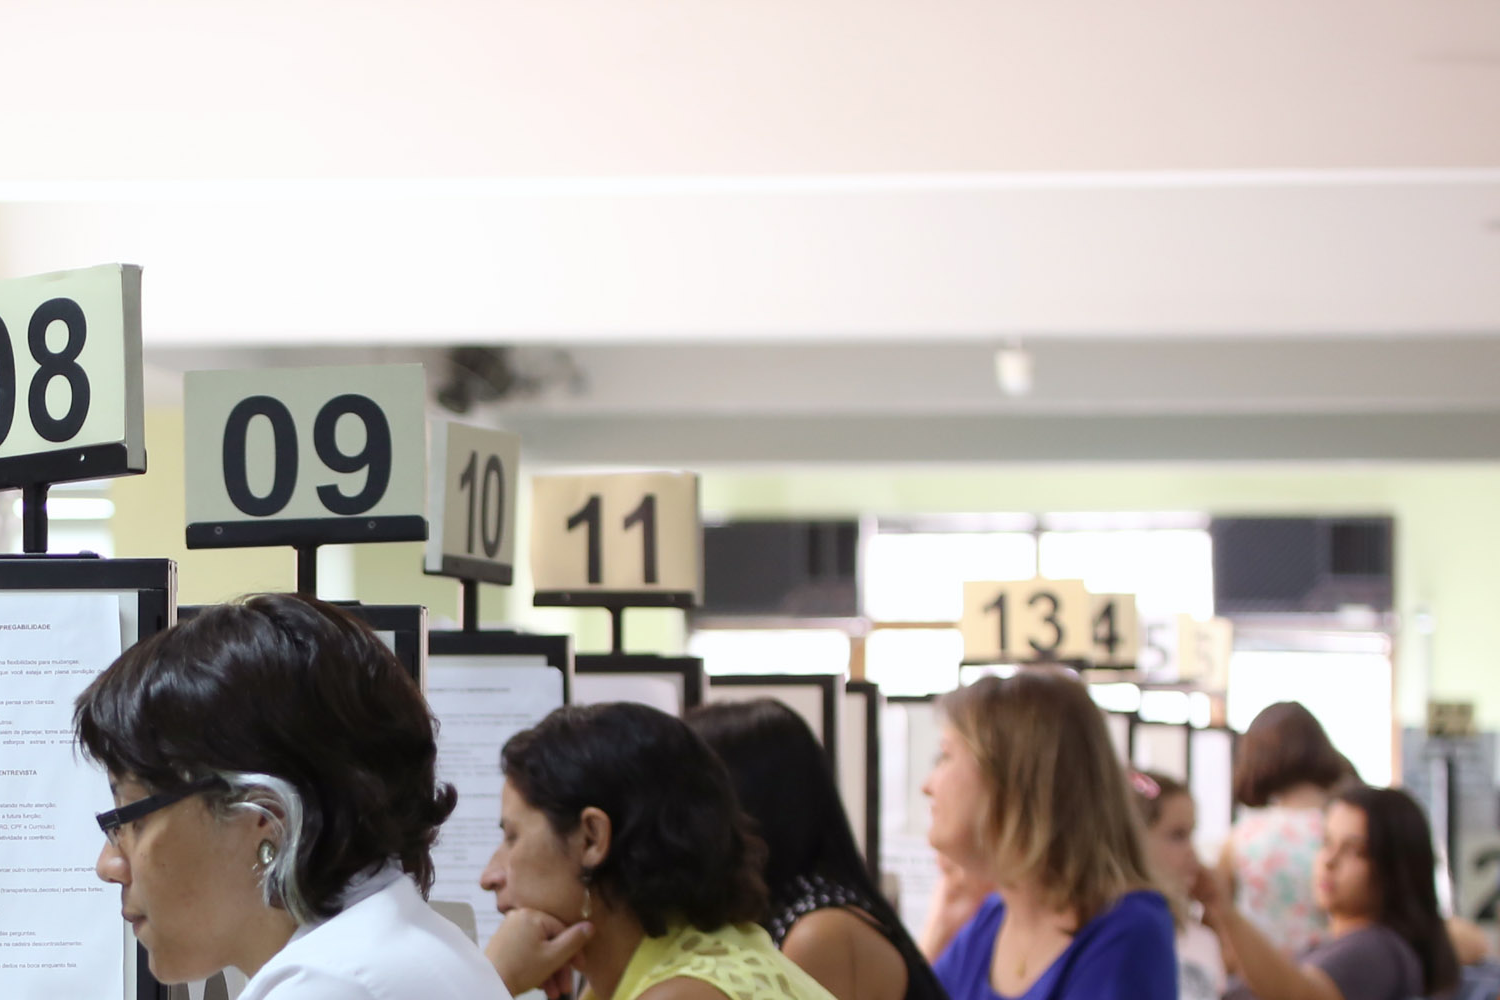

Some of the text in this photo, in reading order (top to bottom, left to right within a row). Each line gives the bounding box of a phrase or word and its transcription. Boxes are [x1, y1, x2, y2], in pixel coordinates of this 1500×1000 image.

[222, 394, 392, 516] 09
[459, 449, 504, 559] 10
[566, 494, 658, 585] 11
[982, 589, 1063, 657] 13
